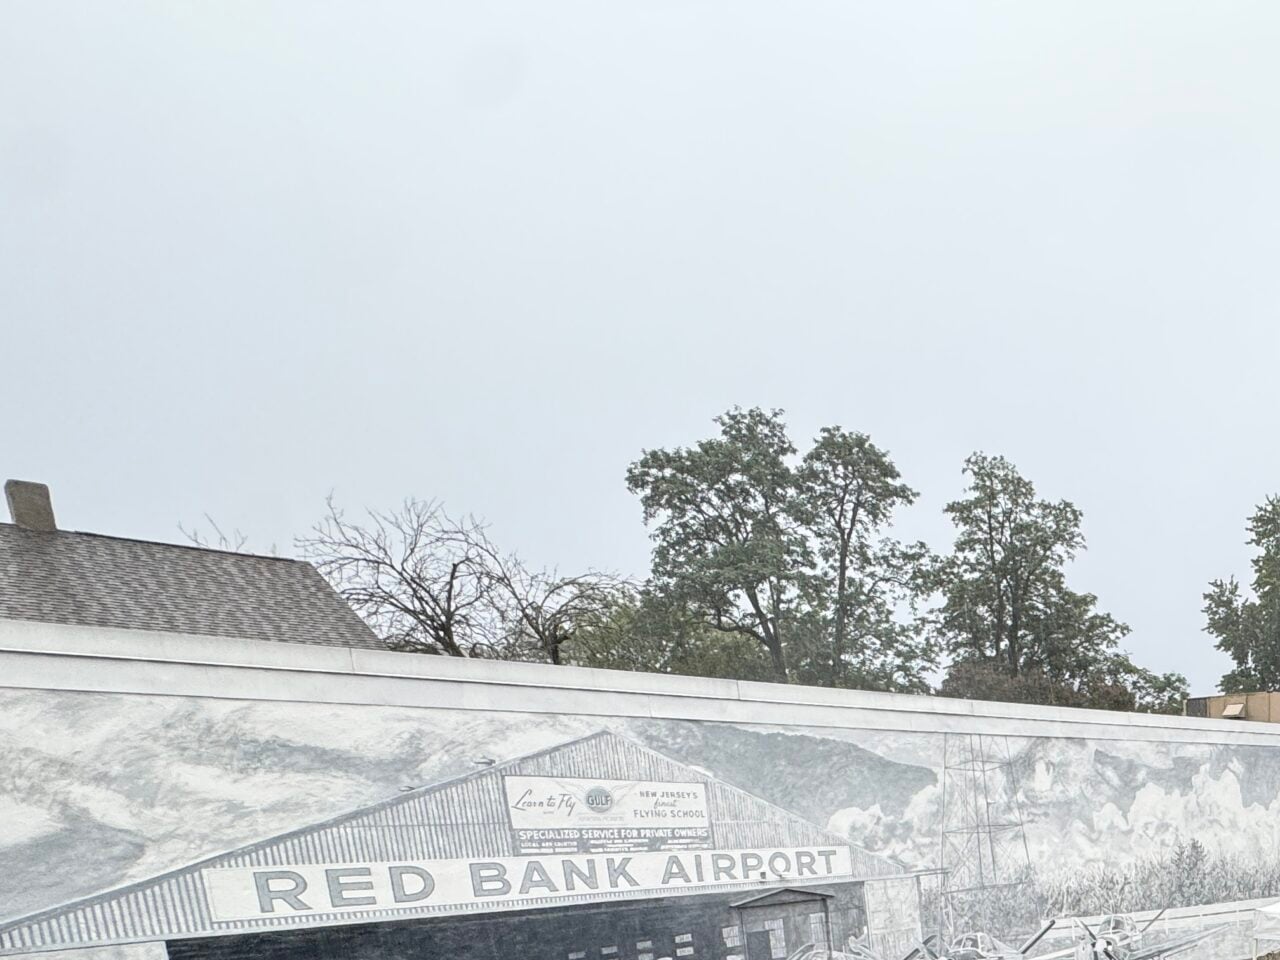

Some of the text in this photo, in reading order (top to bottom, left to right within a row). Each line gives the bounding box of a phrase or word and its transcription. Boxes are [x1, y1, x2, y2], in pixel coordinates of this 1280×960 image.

[587, 794, 611, 806] GULF
[639, 790, 657, 798] NEW
[511, 788, 576, 817] Learn to Fly
[633, 809, 667, 818] FLYING
[670, 809, 706, 818] SCHOOL
[519, 827, 708, 840] SPECIALIZED SERVICE FOR PRIVATE OWNERS
[253, 850, 837, 913] RED BANK AIRPORT
